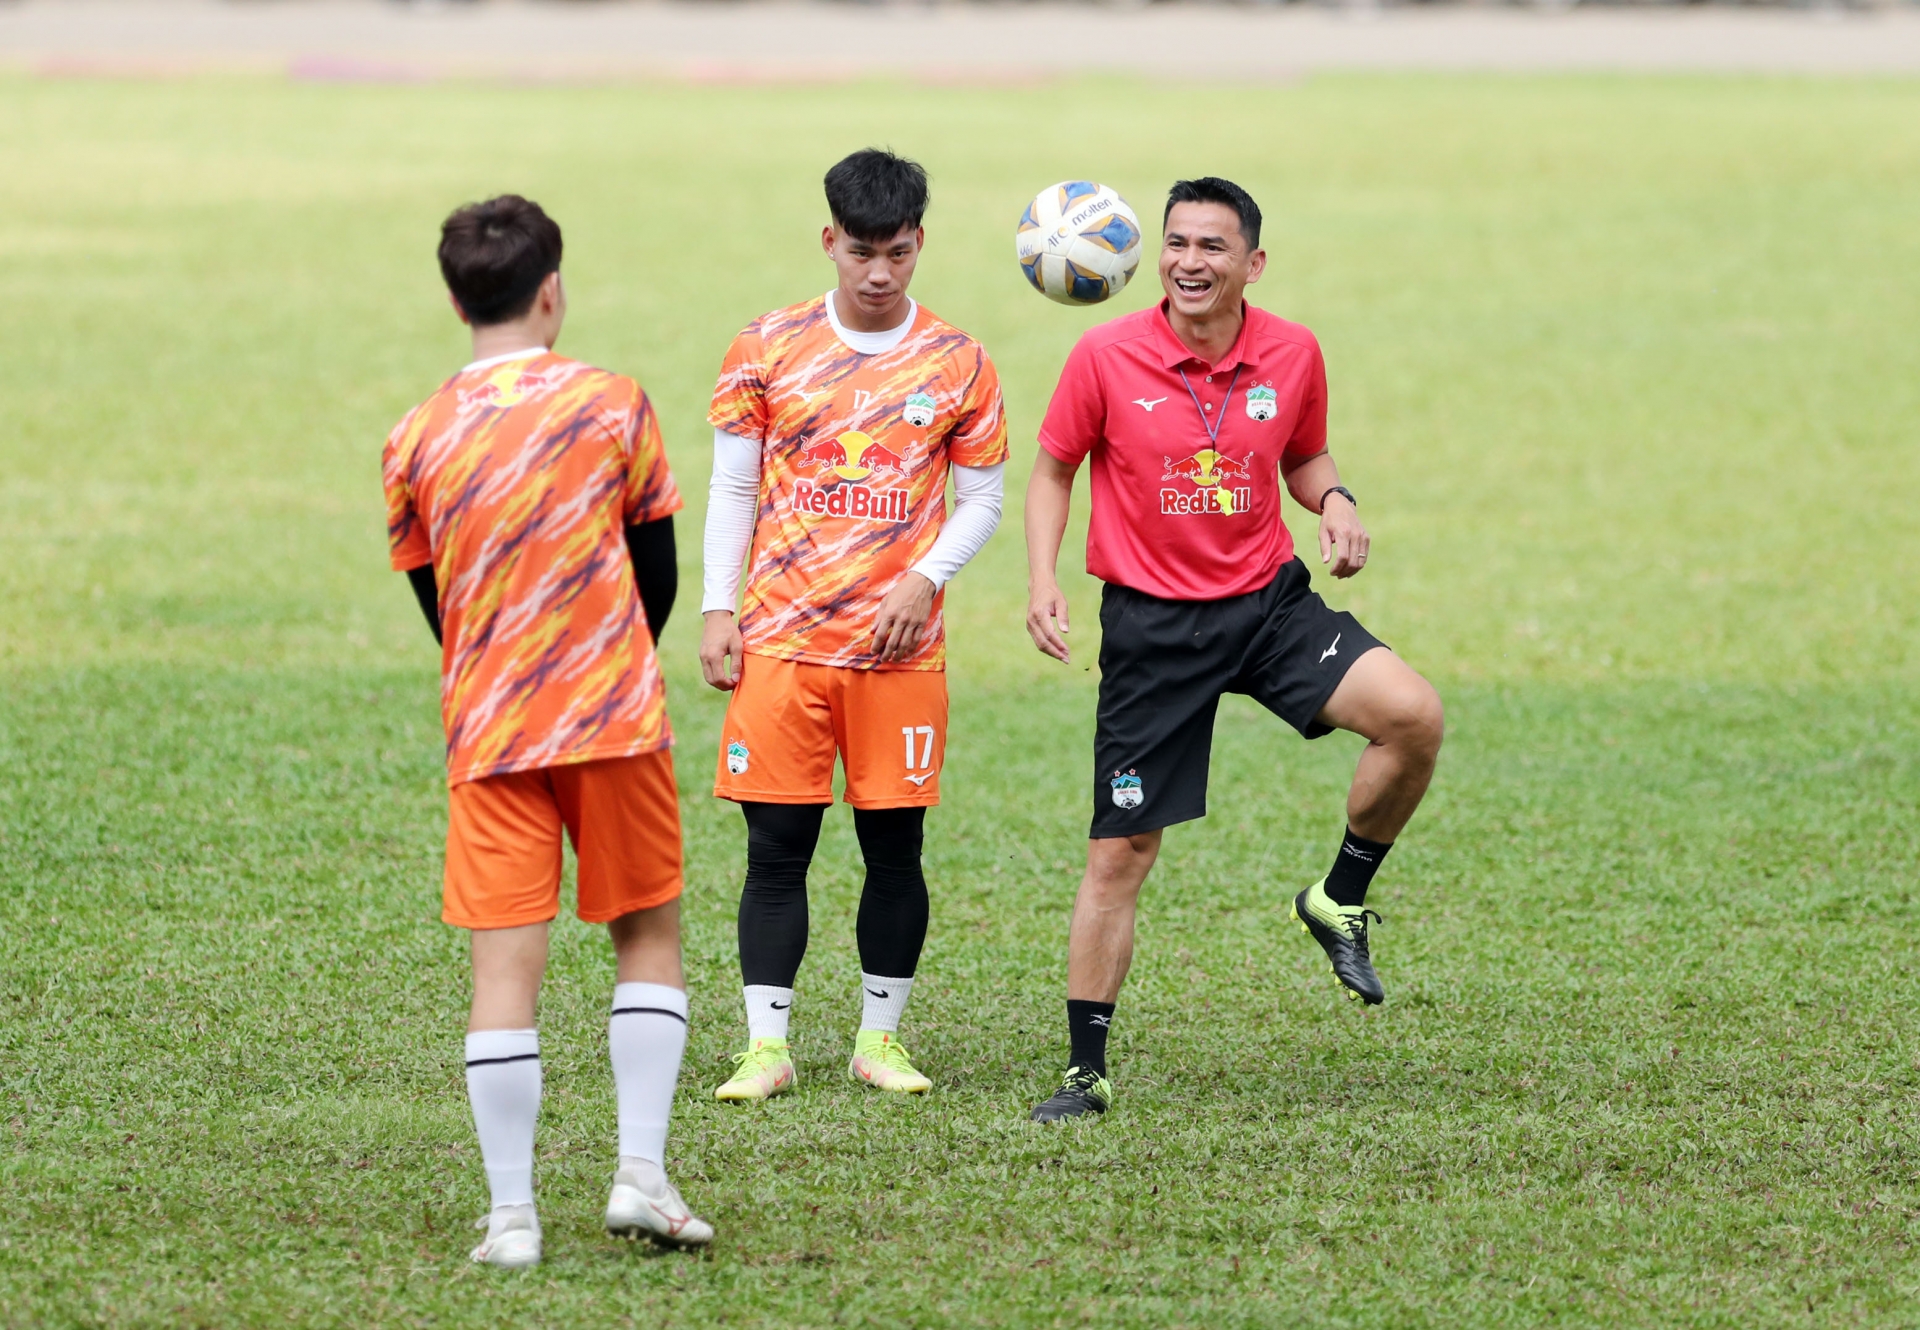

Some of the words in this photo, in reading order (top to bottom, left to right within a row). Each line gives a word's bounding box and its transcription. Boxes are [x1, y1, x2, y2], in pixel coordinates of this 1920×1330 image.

[1072, 199, 1112, 226] molten
[1047, 226, 1070, 253] AFC
[853, 389, 871, 410] 17
[902, 725, 935, 770] 17
